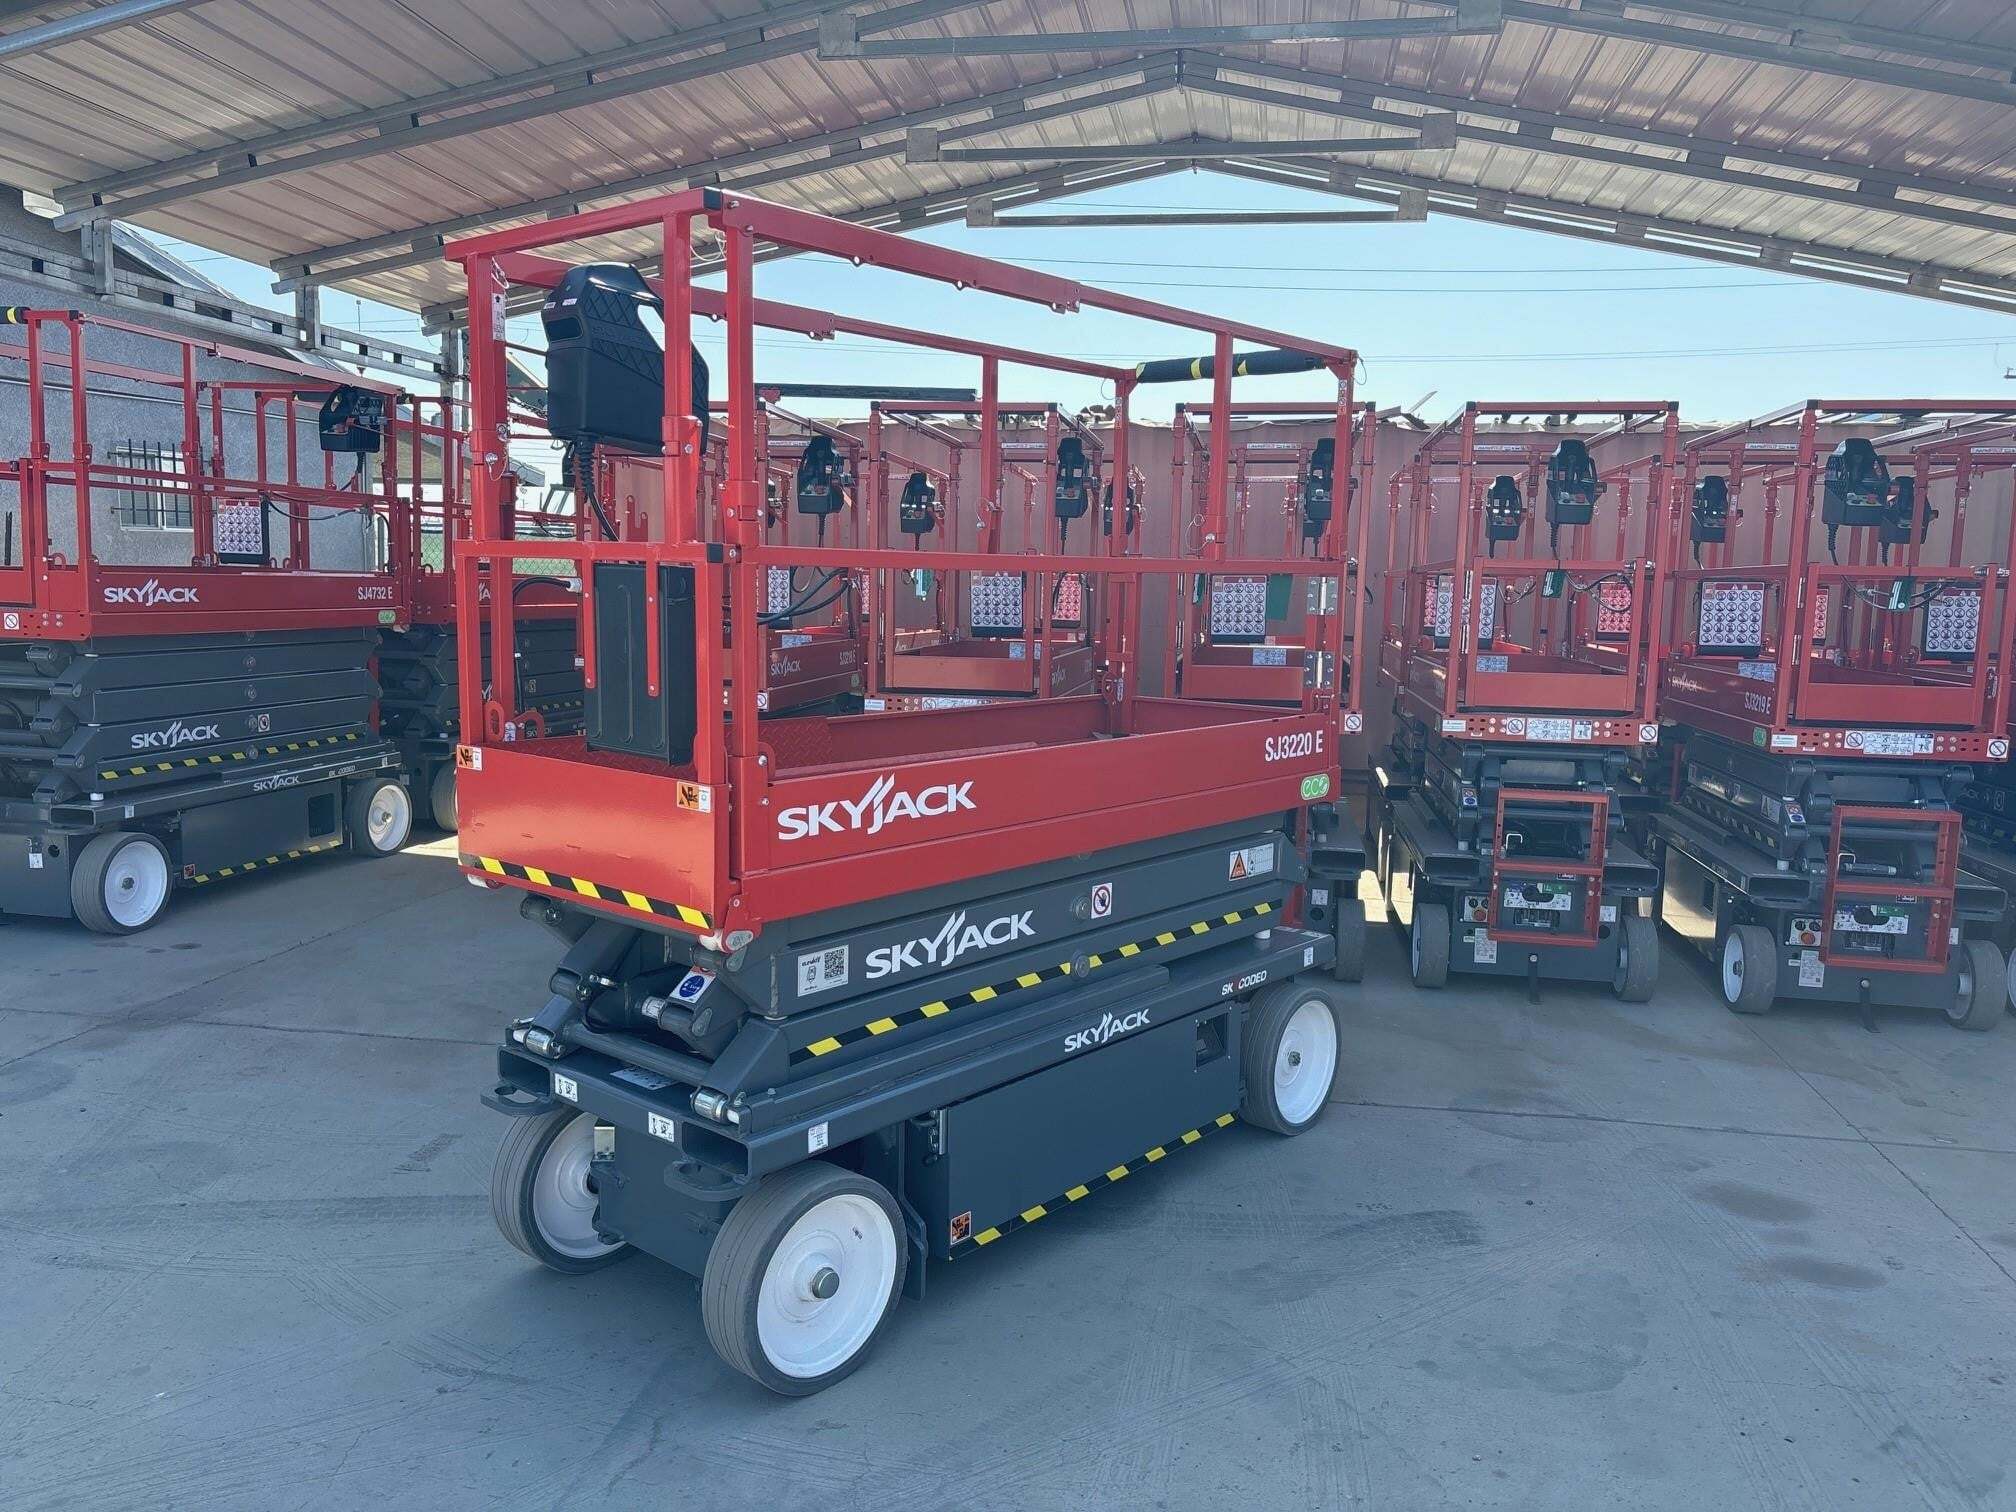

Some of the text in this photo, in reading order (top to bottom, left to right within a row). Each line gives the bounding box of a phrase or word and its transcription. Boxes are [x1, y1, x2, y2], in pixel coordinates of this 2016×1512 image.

[104, 579, 199, 606] SKYJACK
[358, 587, 393, 600] SJ4732 E
[770, 655, 800, 677] SKYJACK
[131, 720, 220, 749] SKYJACK
[1265, 730, 1323, 762] SJ3220 E
[253, 775, 300, 792] SKYJACK
[777, 773, 977, 840] SKYJACK
[866, 910, 1036, 979] SKYJACK
[1064, 1008, 1151, 1052] SKYJACK
